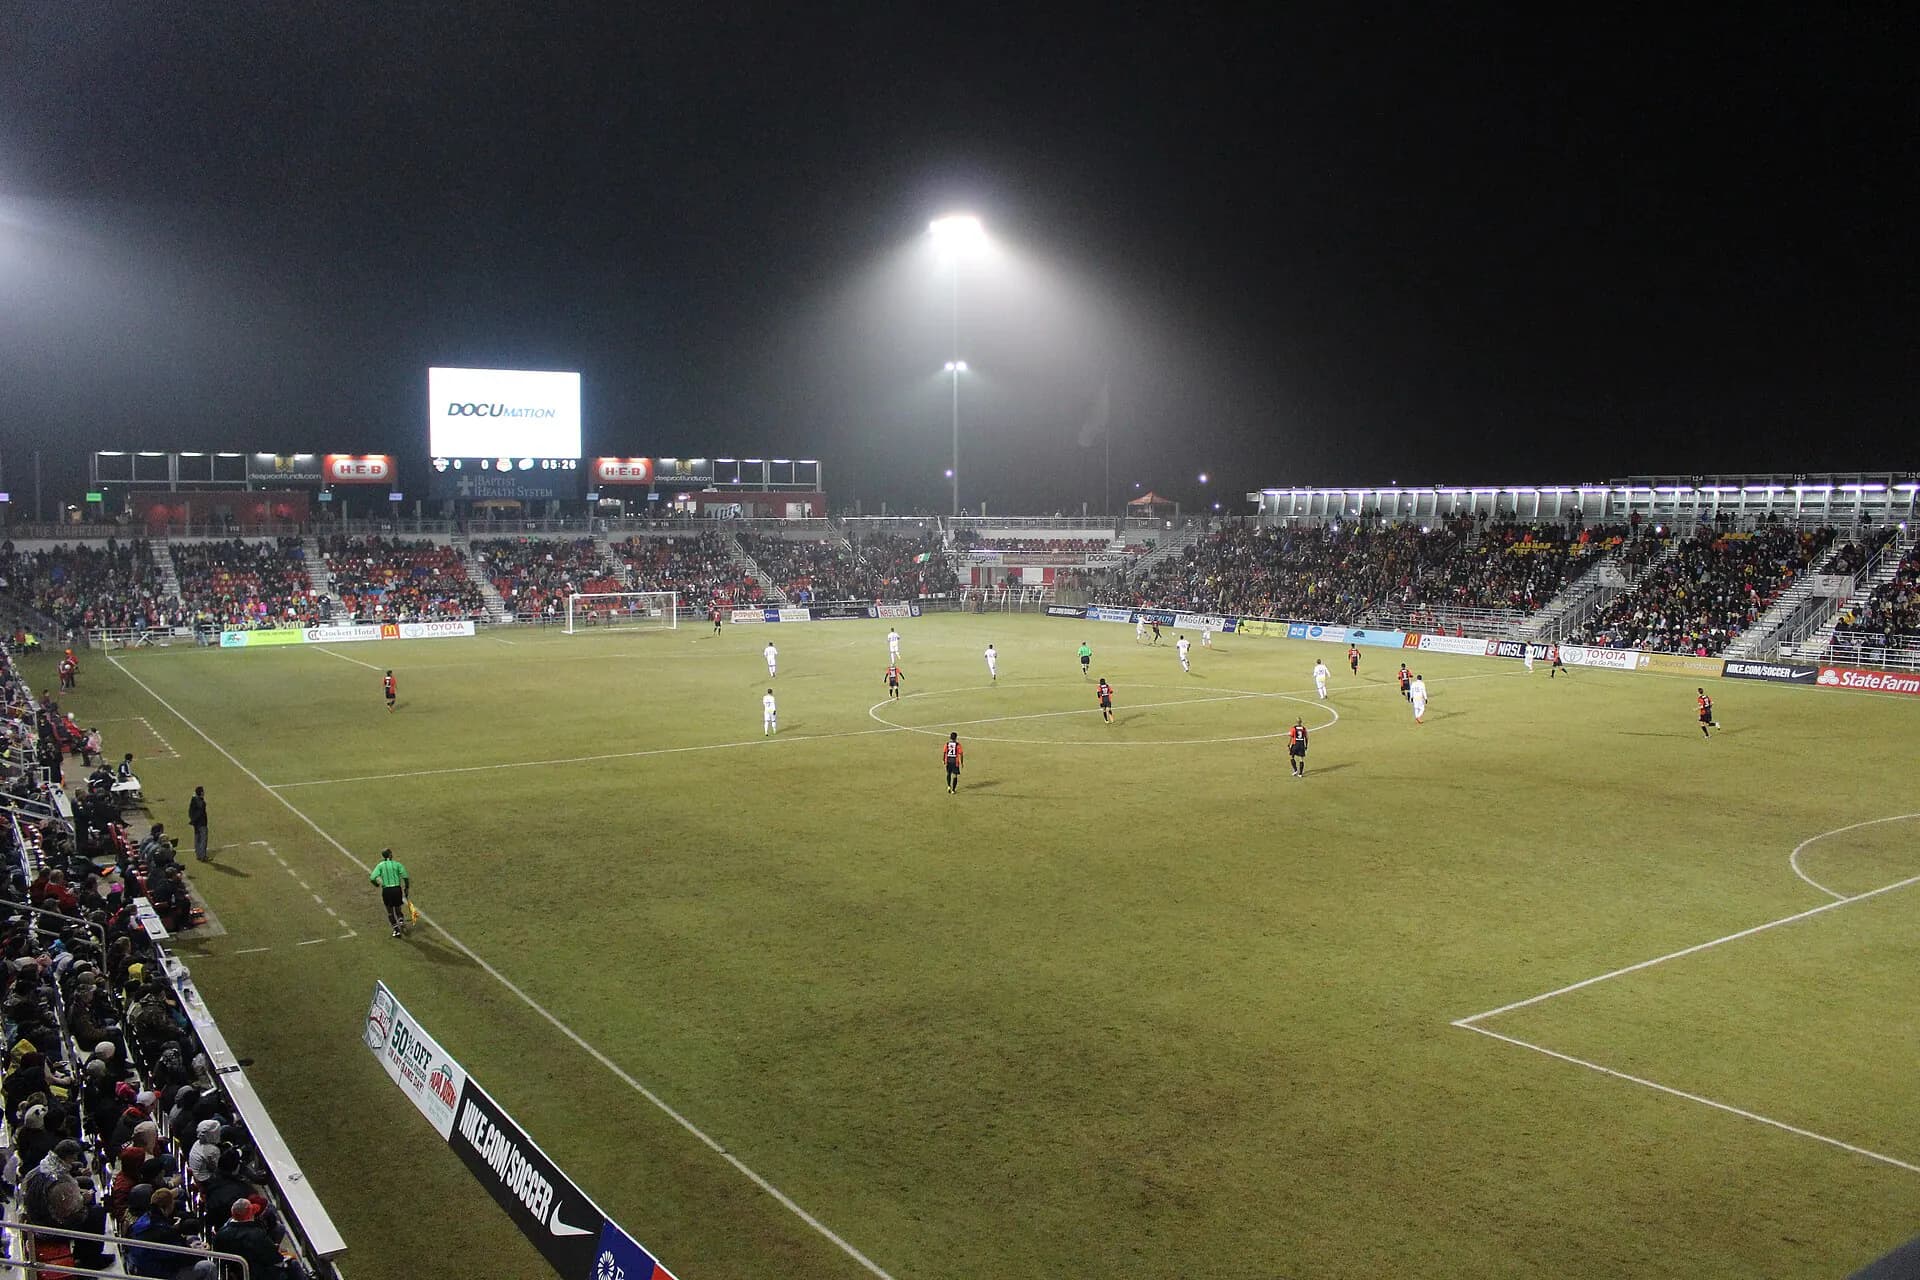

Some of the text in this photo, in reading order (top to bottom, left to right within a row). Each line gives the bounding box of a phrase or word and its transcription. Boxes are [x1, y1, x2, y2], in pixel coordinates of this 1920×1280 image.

[447, 402, 557, 418] DOCUMATION
[454, 459, 462, 470] 0
[481, 459, 489, 470] 0
[478, 475, 516, 487] BAPTIST
[478, 486, 553, 497] HEALTH SYSTEM
[320, 628, 376, 637] Crockett Hotel
[426, 622, 464, 631] TOYOTA
[1585, 649, 1626, 661] TOYOTA
[1726, 663, 1791, 679] NIKE.COM/SOCCER
[391, 1019, 416, 1056] 50%
[413, 1041, 433, 1071] OFF
[429, 1071, 444, 1096] PAPA
[458, 1098, 554, 1226] NIKE.COM/SOCCER
